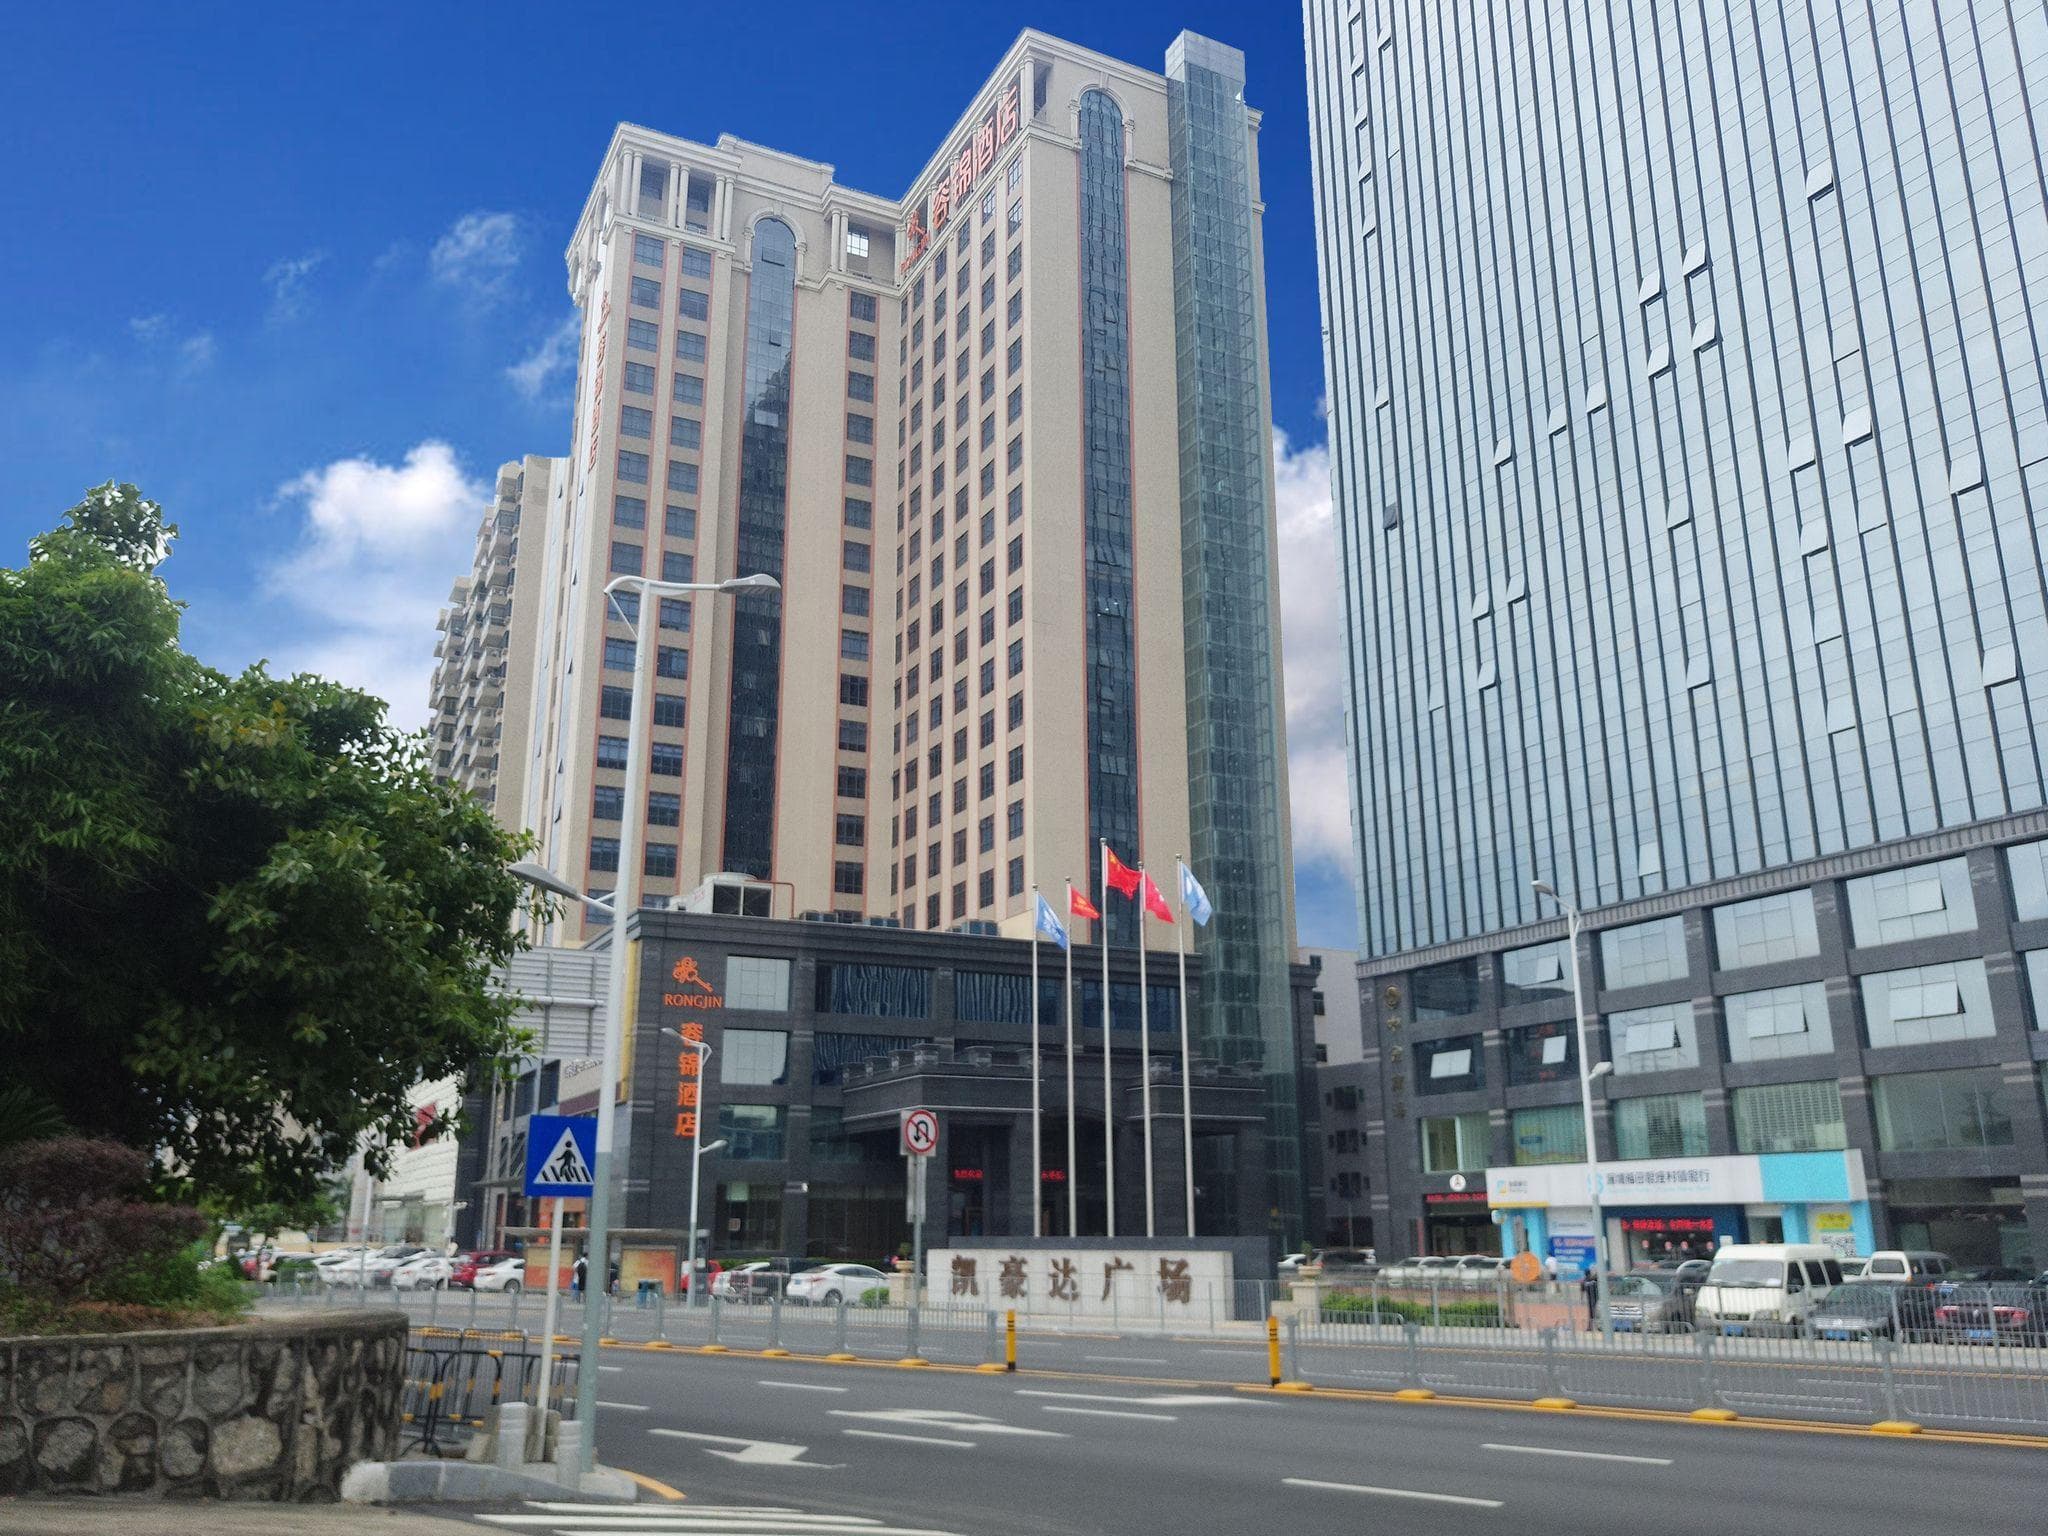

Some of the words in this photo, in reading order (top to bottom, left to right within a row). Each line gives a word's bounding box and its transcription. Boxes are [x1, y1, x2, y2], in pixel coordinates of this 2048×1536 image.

[933, 85, 1018, 230] 容锦酒店
[663, 992, 723, 1009] RONGJIN
[675, 1022, 704, 1138] 容锦酒店
[951, 1254, 1193, 1303] 凯豪达广场
